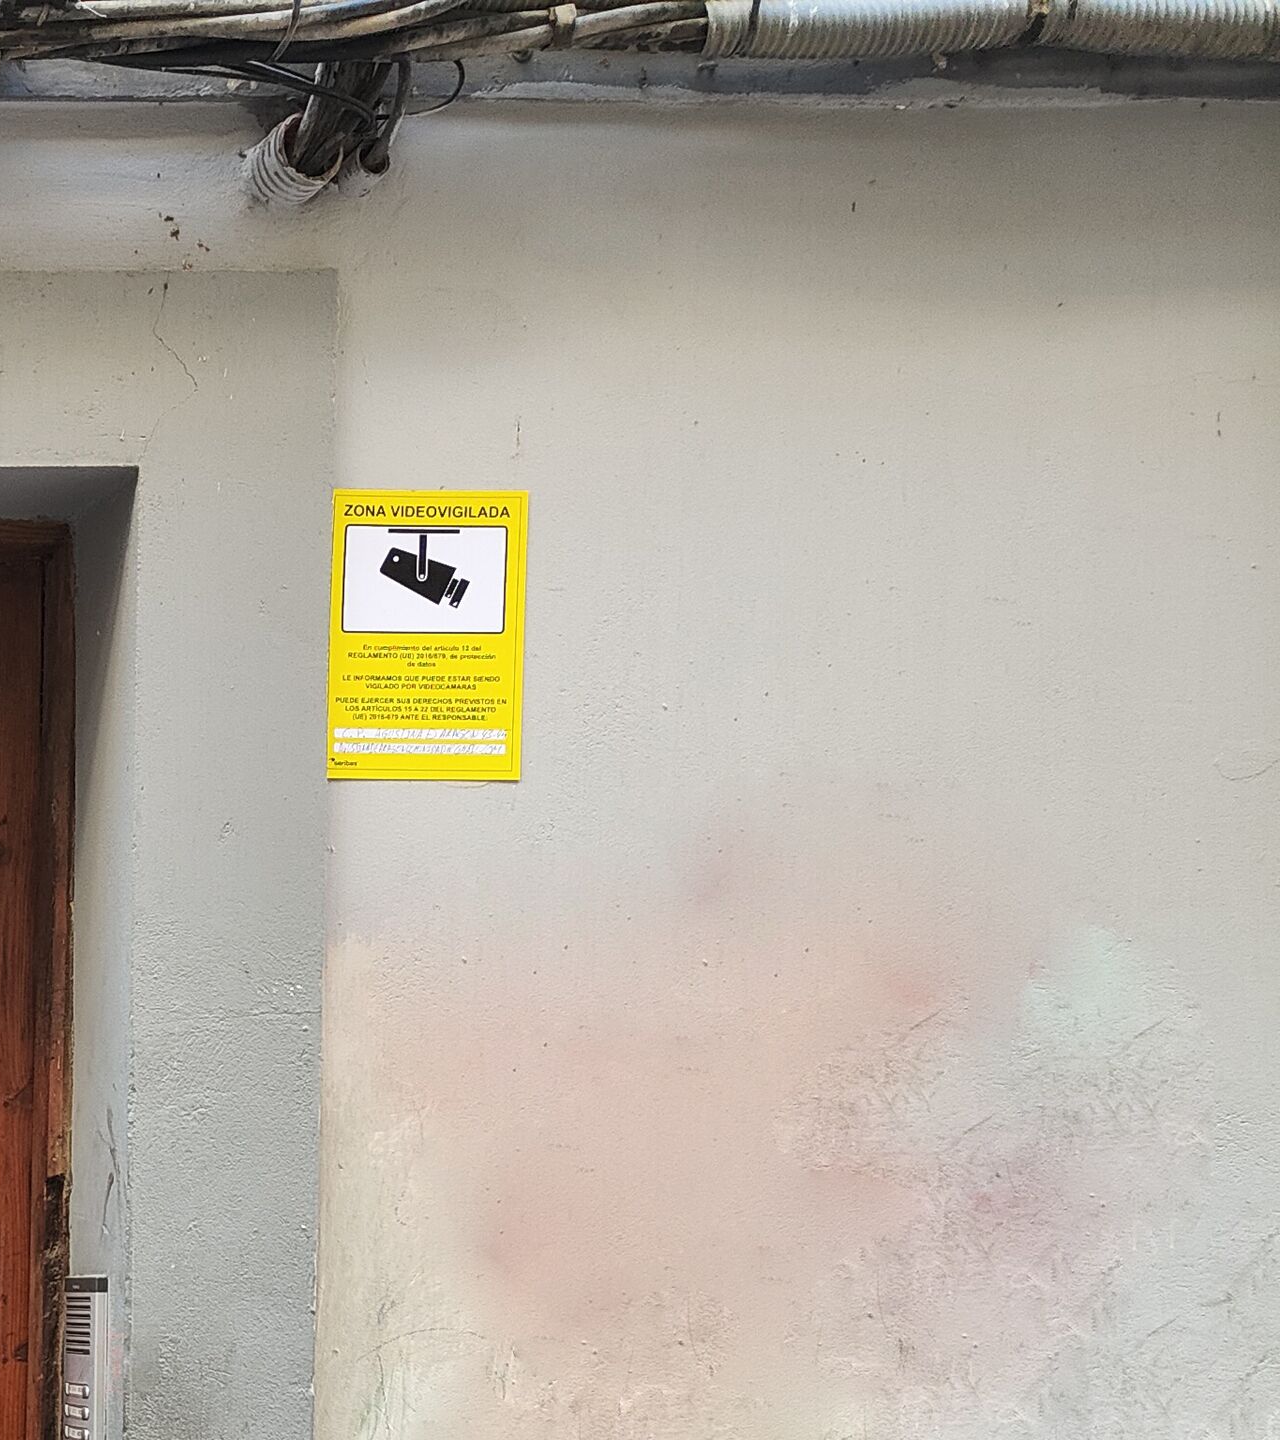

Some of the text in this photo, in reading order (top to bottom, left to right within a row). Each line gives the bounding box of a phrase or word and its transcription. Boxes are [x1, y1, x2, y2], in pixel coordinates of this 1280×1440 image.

[344, 504, 510, 518] ZONA VIDEOVIGILADA
[353, 674, 403, 682] INFORMAMOS
[405, 674, 419, 682] QUE
